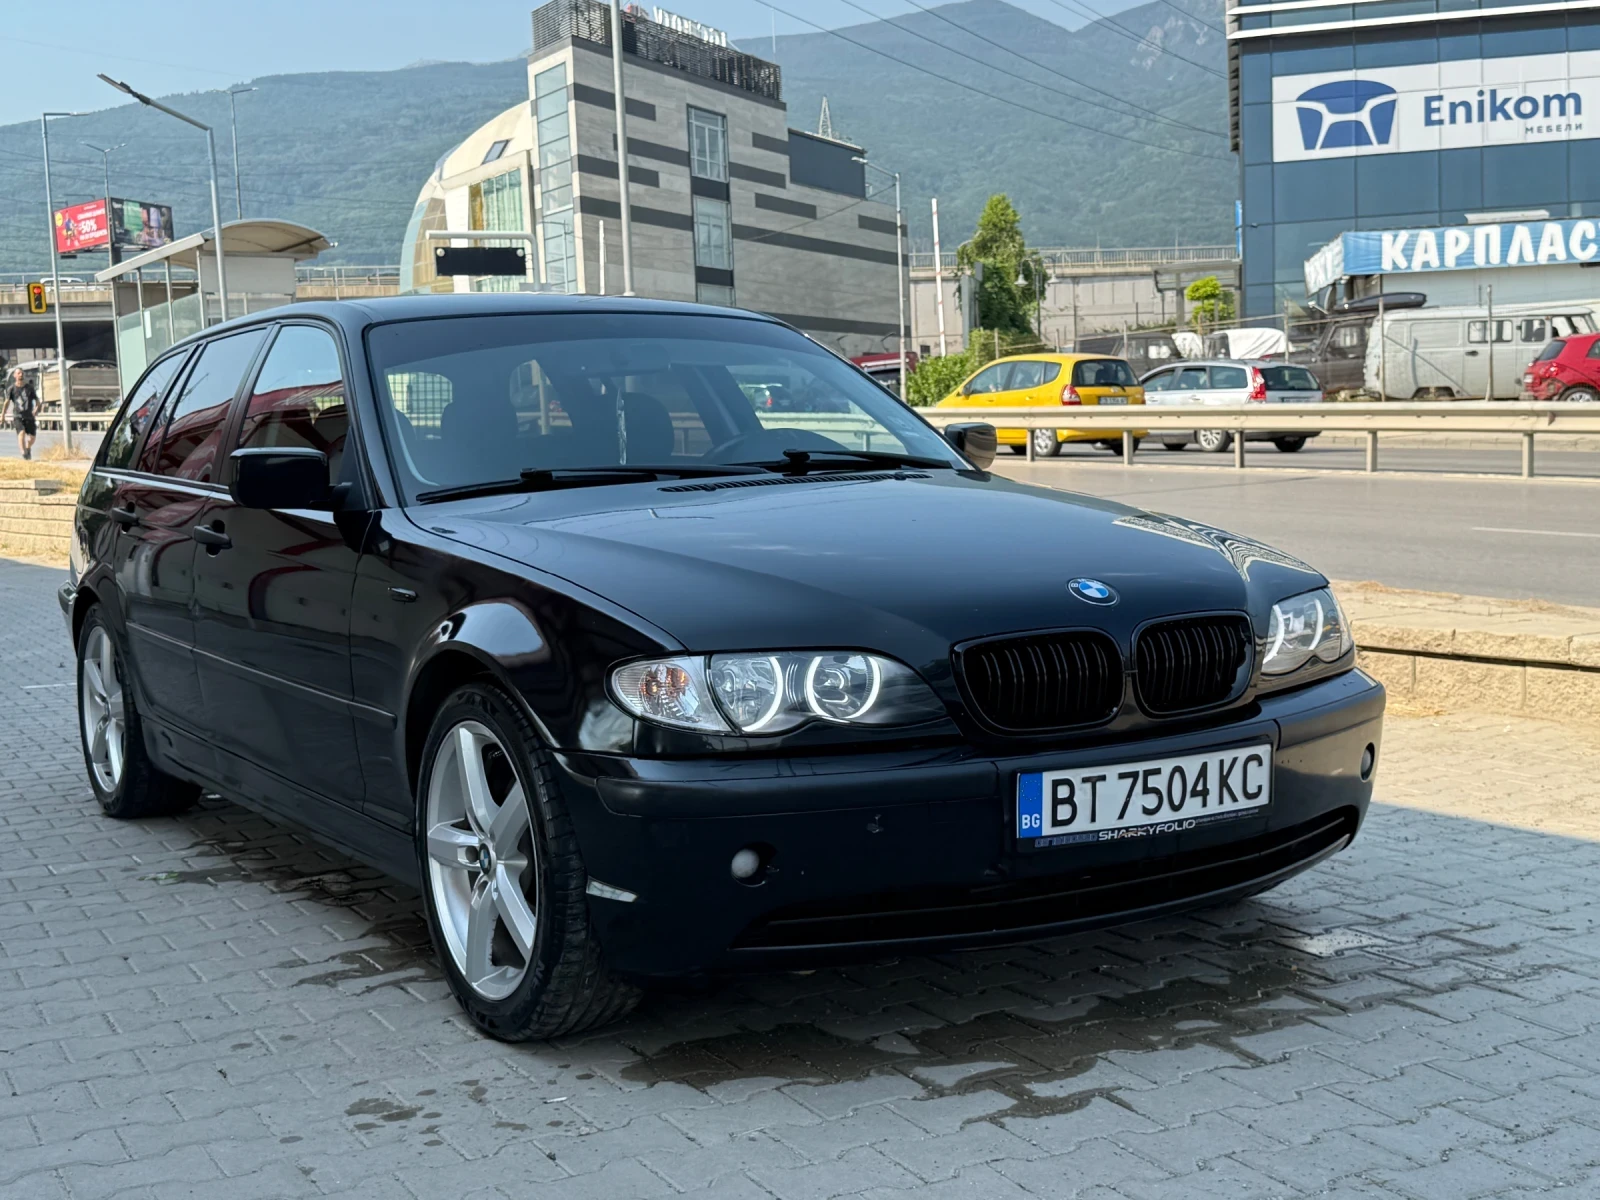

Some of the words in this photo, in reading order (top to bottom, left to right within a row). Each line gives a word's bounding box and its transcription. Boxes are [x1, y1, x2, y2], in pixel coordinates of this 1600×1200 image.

[1423, 89, 1582, 127] Enikom
[1525, 123, 1583, 135] МЕБЕЛИ
[1381, 220, 1600, 271] КАРПЛАС
[1051, 774, 1107, 828] BT
[1116, 761, 1210, 820] 7504
[1218, 754, 1263, 806] KC
[1021, 813, 1041, 829] BG
[1098, 819, 1196, 841] SHARKYFOLIO
